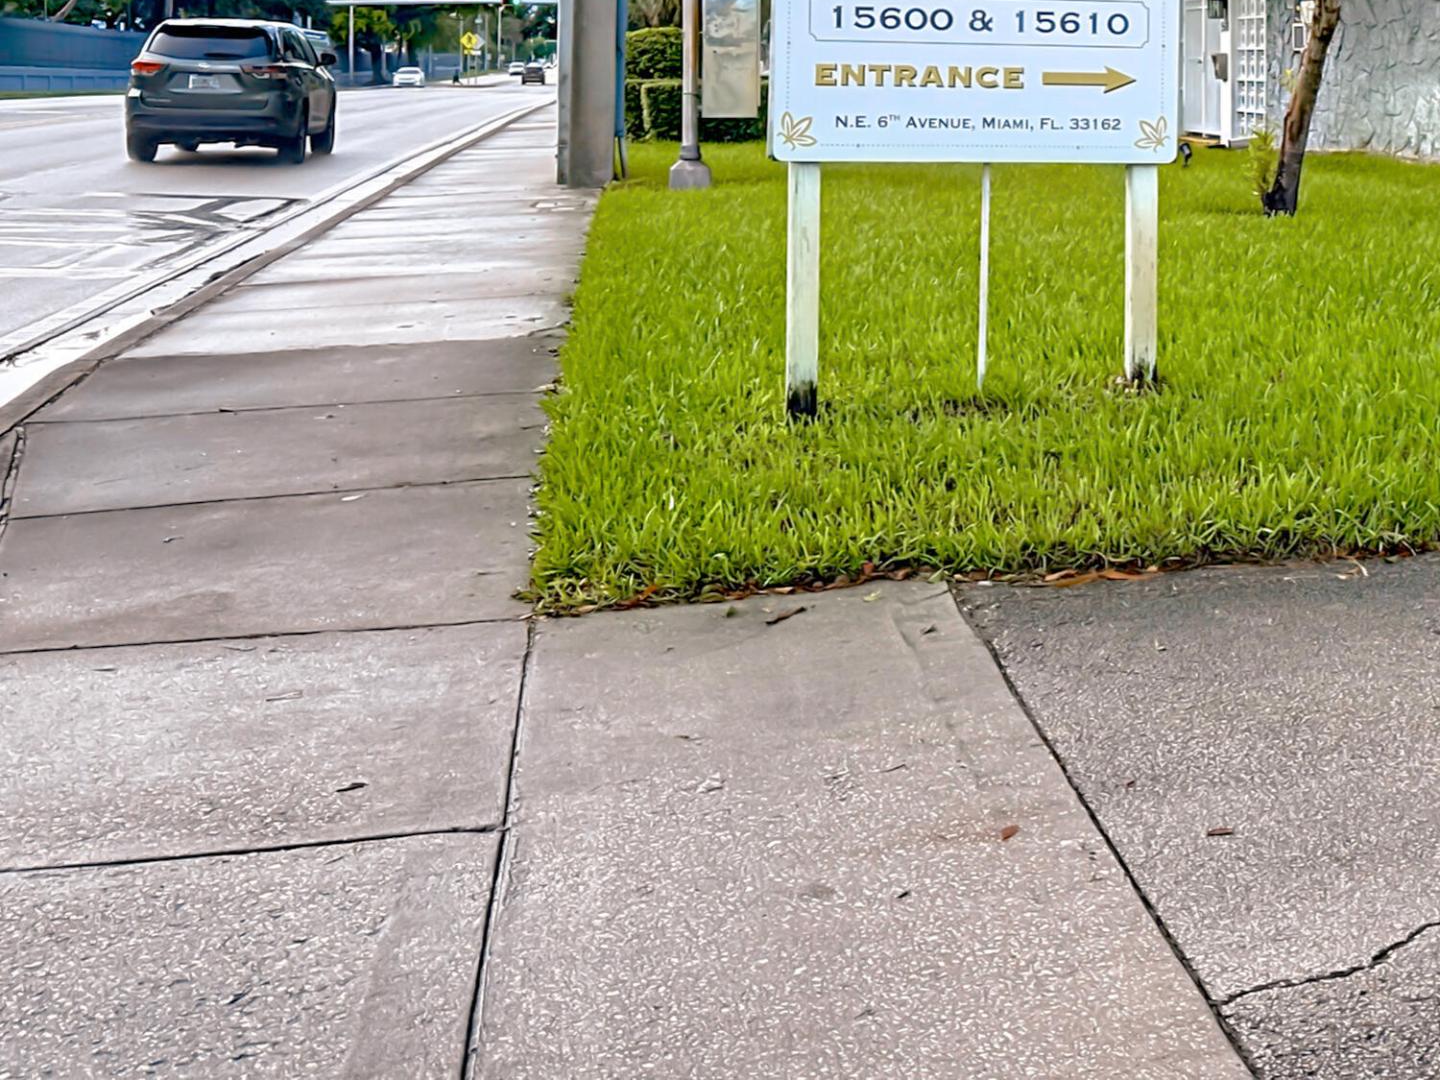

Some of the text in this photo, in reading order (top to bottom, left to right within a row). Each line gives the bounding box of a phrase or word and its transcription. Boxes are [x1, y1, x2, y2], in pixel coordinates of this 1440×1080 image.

[832, 5, 1130, 35] 15600 & 15610
[815, 63, 1025, 89] ENTRANCE
[835, 115, 871, 128] N.E.
[905, 116, 976, 131] AVENUE,
[982, 117, 1034, 132] MIAMI,
[1069, 118, 1122, 131] 33162
